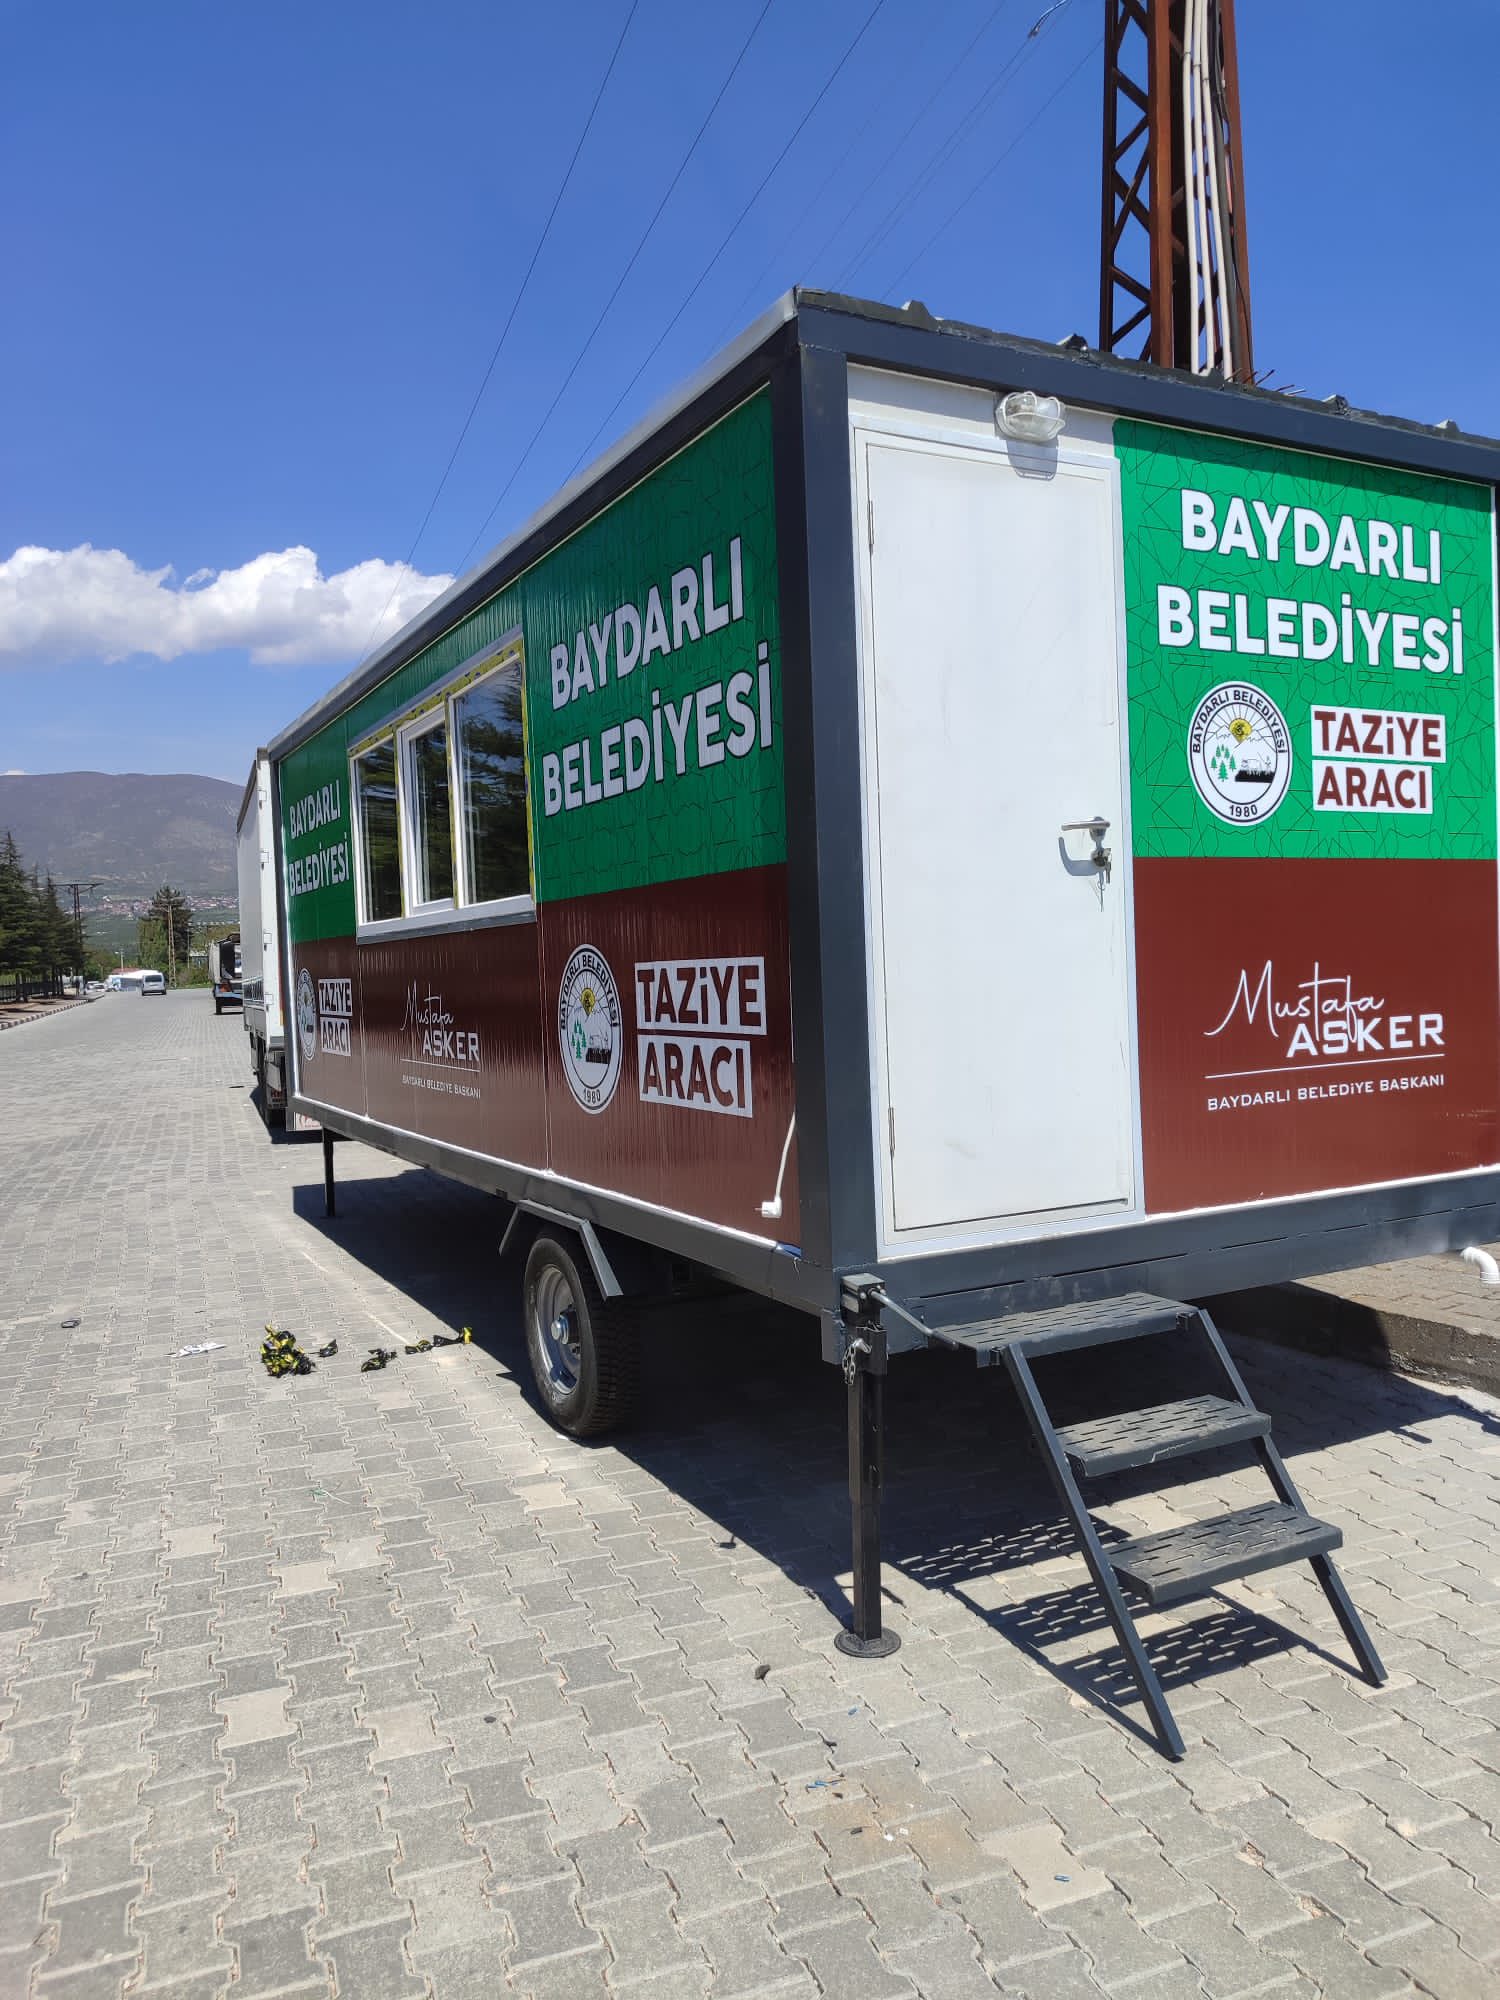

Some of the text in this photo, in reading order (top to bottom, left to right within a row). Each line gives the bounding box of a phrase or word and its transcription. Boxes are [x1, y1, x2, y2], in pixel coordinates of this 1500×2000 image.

[1181, 488, 1441, 584] BAYDARLI
[550, 535, 744, 711] BAYDARLI
[1157, 584, 1464, 675] BELEDİYESİ
[542, 641, 773, 817] BELEDİYESİ
[1193, 690, 1288, 753] BAYDARLI BELEDİYESİ
[289, 779, 341, 840] BAYDARLI
[1229, 804, 1258, 817] 1980
[1317, 766, 1427, 809] ARACI
[288, 831, 350, 897] BELEDİYESİ
[1203, 959, 1385, 1043] Mustafa
[322, 1021, 350, 1053] ARACI
[423, 1029, 480, 1062] ASKER
[1286, 1013, 1445, 1058] ASKER
[583, 1088, 601, 1104] 1980
[642, 1041, 746, 1109] ARACI
[1208, 1089, 1290, 1111] BAYDARLI
